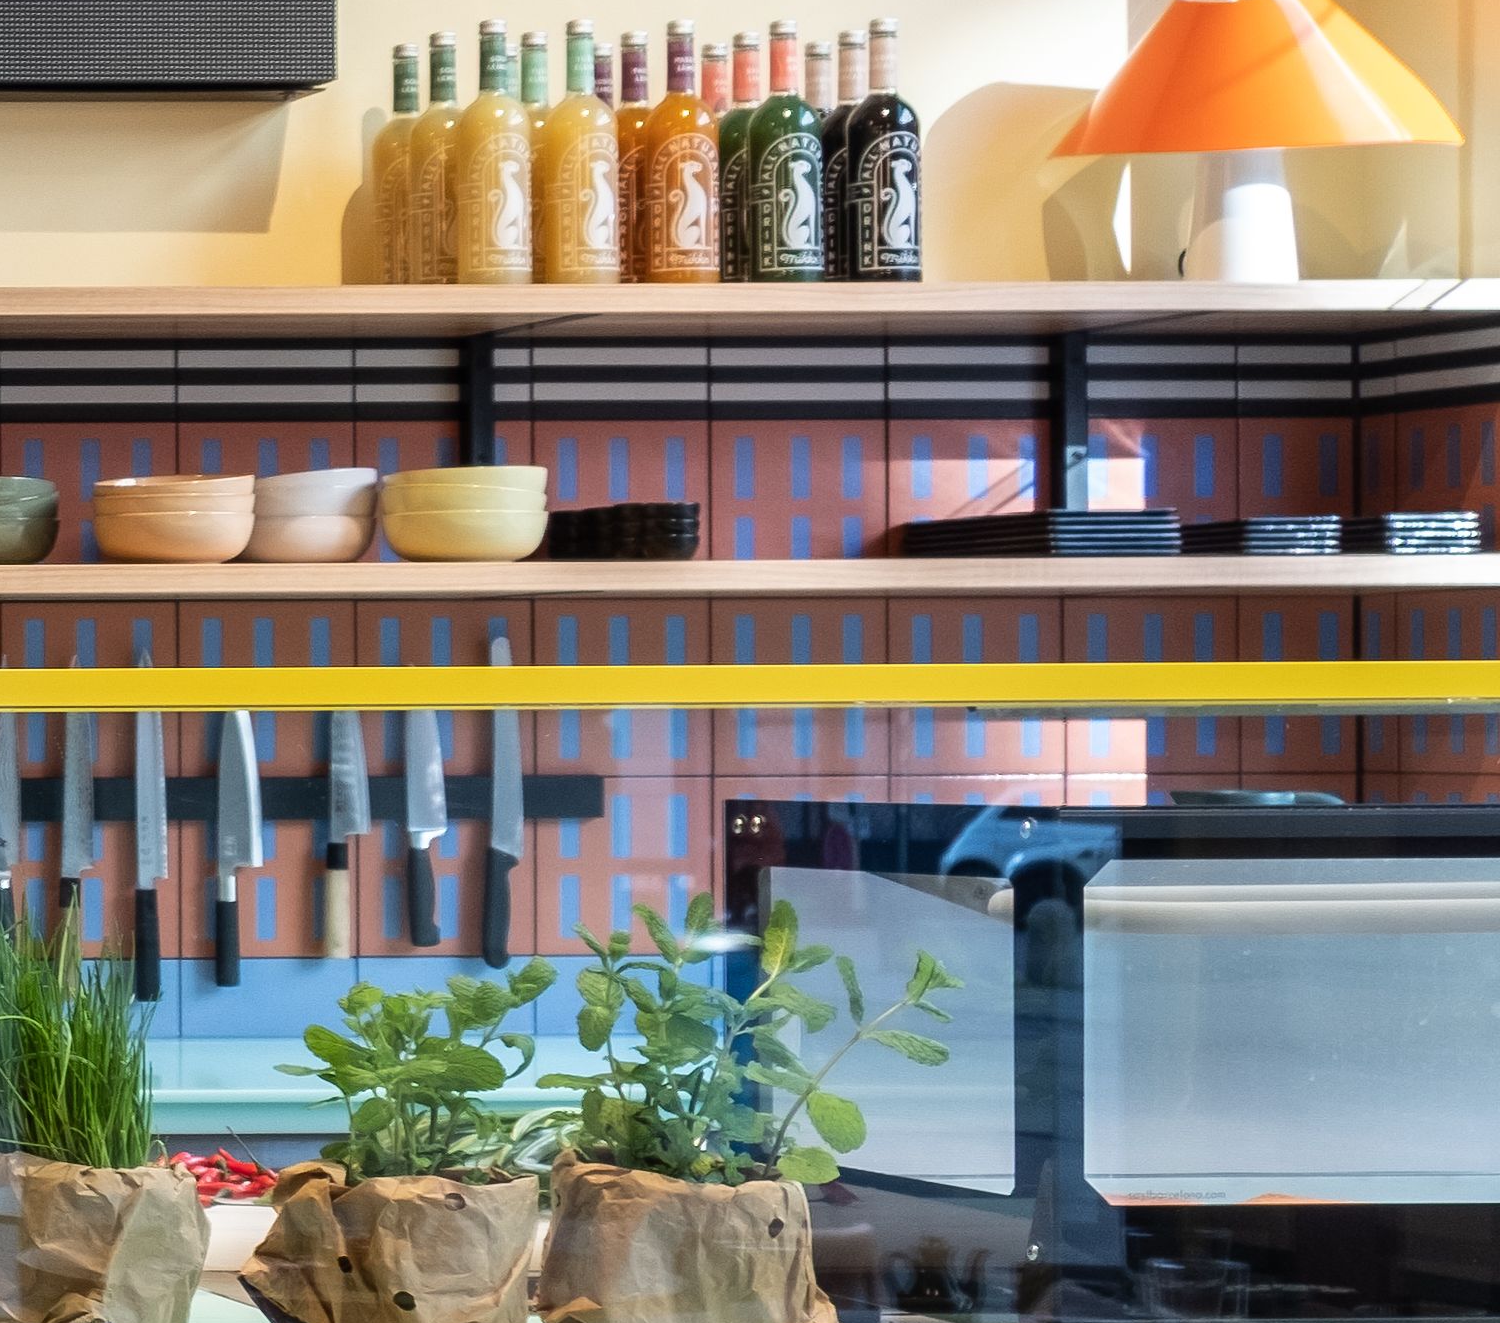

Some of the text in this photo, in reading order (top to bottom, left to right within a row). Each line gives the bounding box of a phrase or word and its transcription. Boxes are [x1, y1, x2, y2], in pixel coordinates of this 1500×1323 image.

[762, 154, 779, 179] ALL
[862, 153, 879, 178] ALL
[763, 203, 772, 267] DRINK
[863, 203, 872, 266] DRINK
